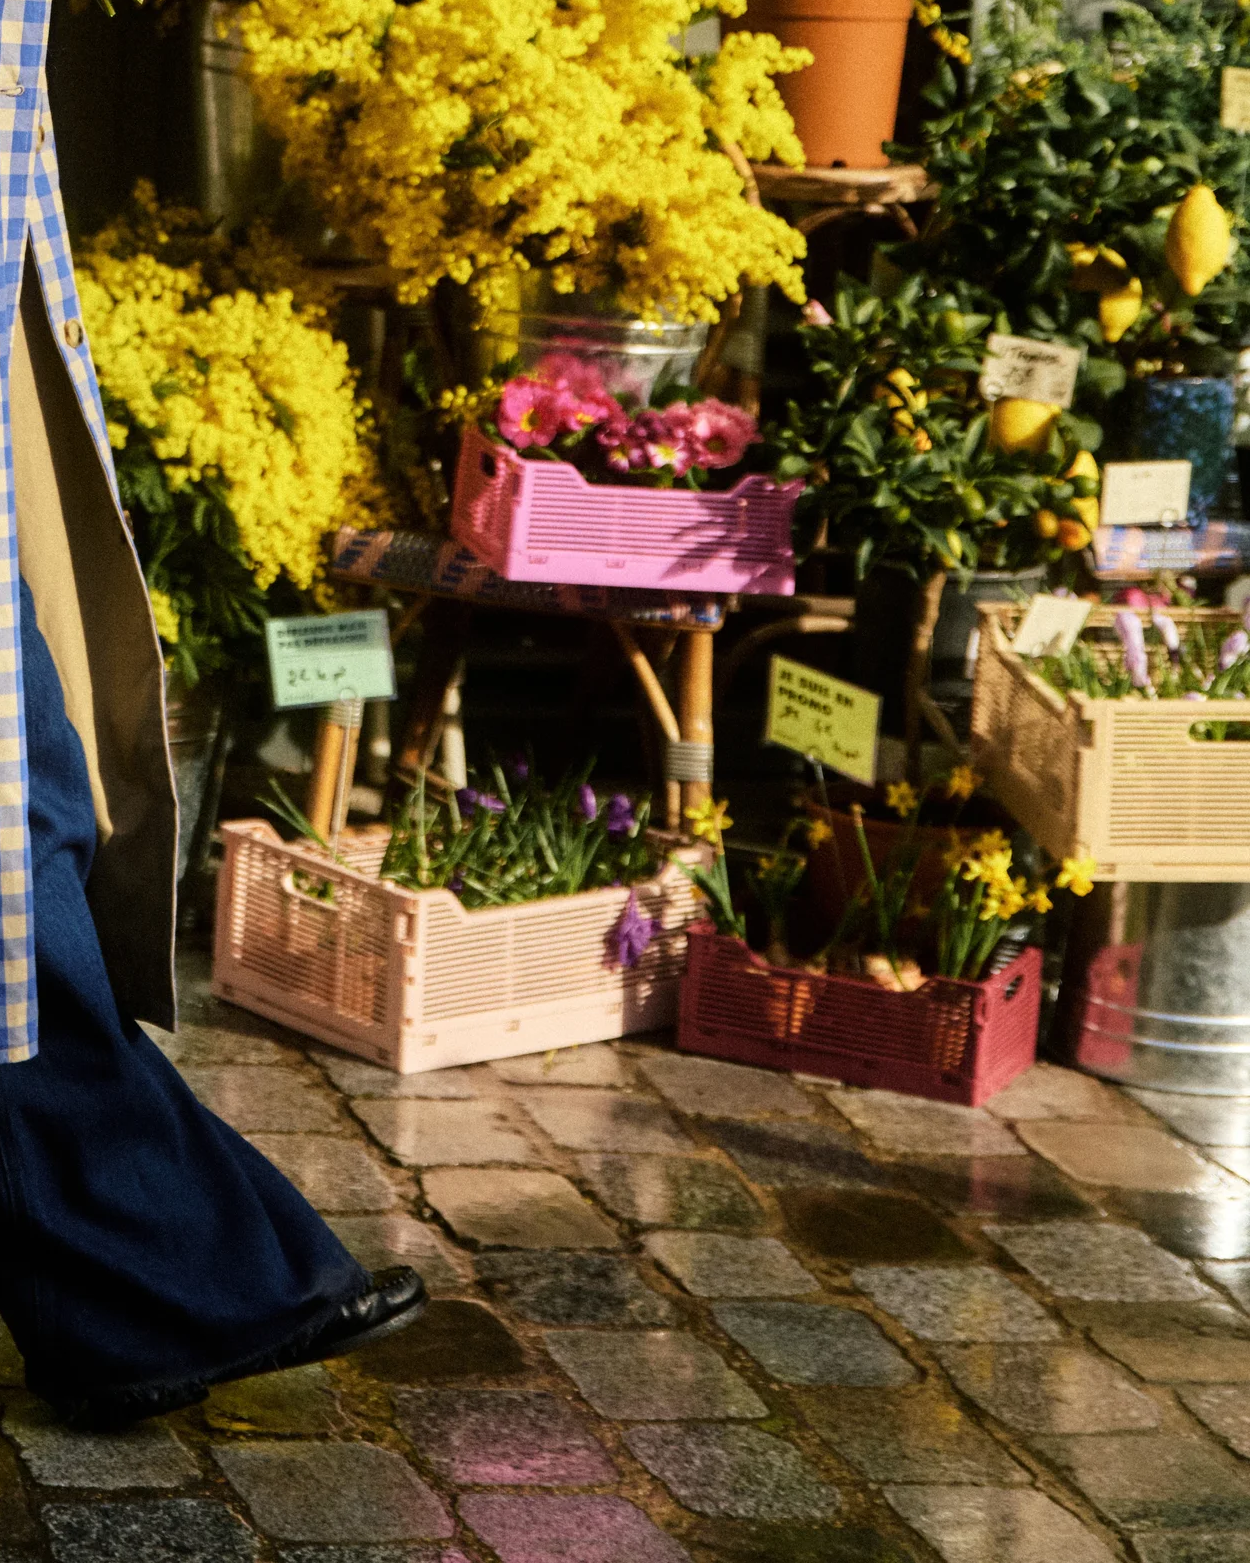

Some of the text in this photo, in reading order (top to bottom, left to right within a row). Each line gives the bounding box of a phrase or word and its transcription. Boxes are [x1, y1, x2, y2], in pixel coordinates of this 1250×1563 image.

[778, 685, 833, 716] PROMO
[779, 669, 855, 708] JE SUIS EN
